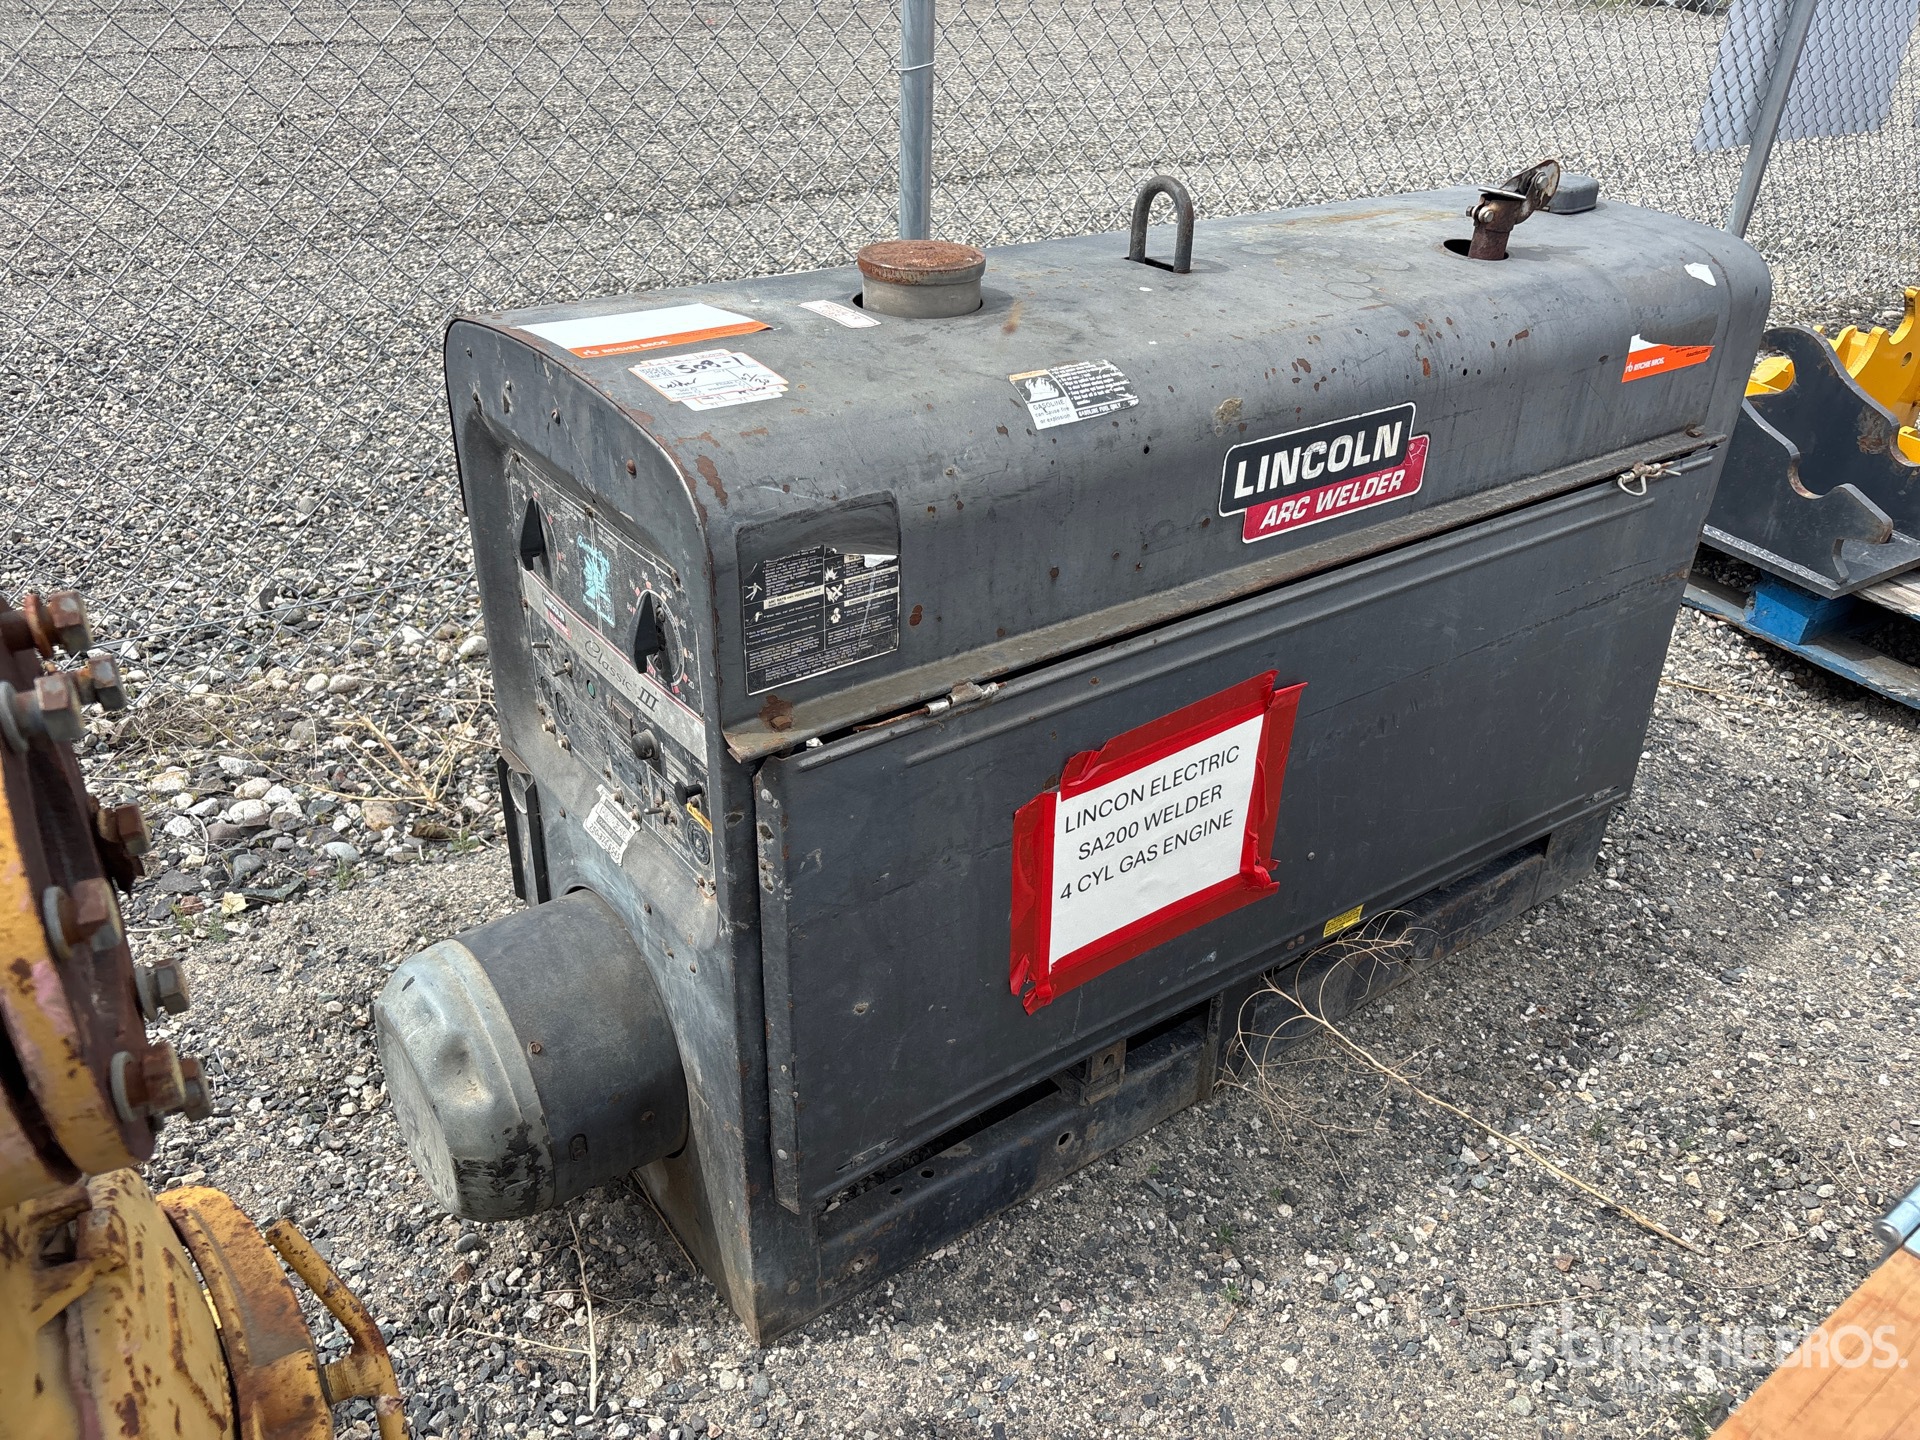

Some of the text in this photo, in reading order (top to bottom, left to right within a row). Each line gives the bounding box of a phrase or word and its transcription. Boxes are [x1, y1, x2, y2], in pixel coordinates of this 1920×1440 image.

[1033, 398, 1065, 411] GASOLINE
[1233, 421, 1403, 499] LINCOLN
[1259, 469, 1406, 530] ARC WELDER
[584, 640, 660, 713] Classic III
[1064, 745, 1241, 834] LINCON ELECTRIC
[1077, 784, 1223, 861] SA200 WELDER
[1059, 809, 1235, 900] 4 CYL GAS ENGINE
